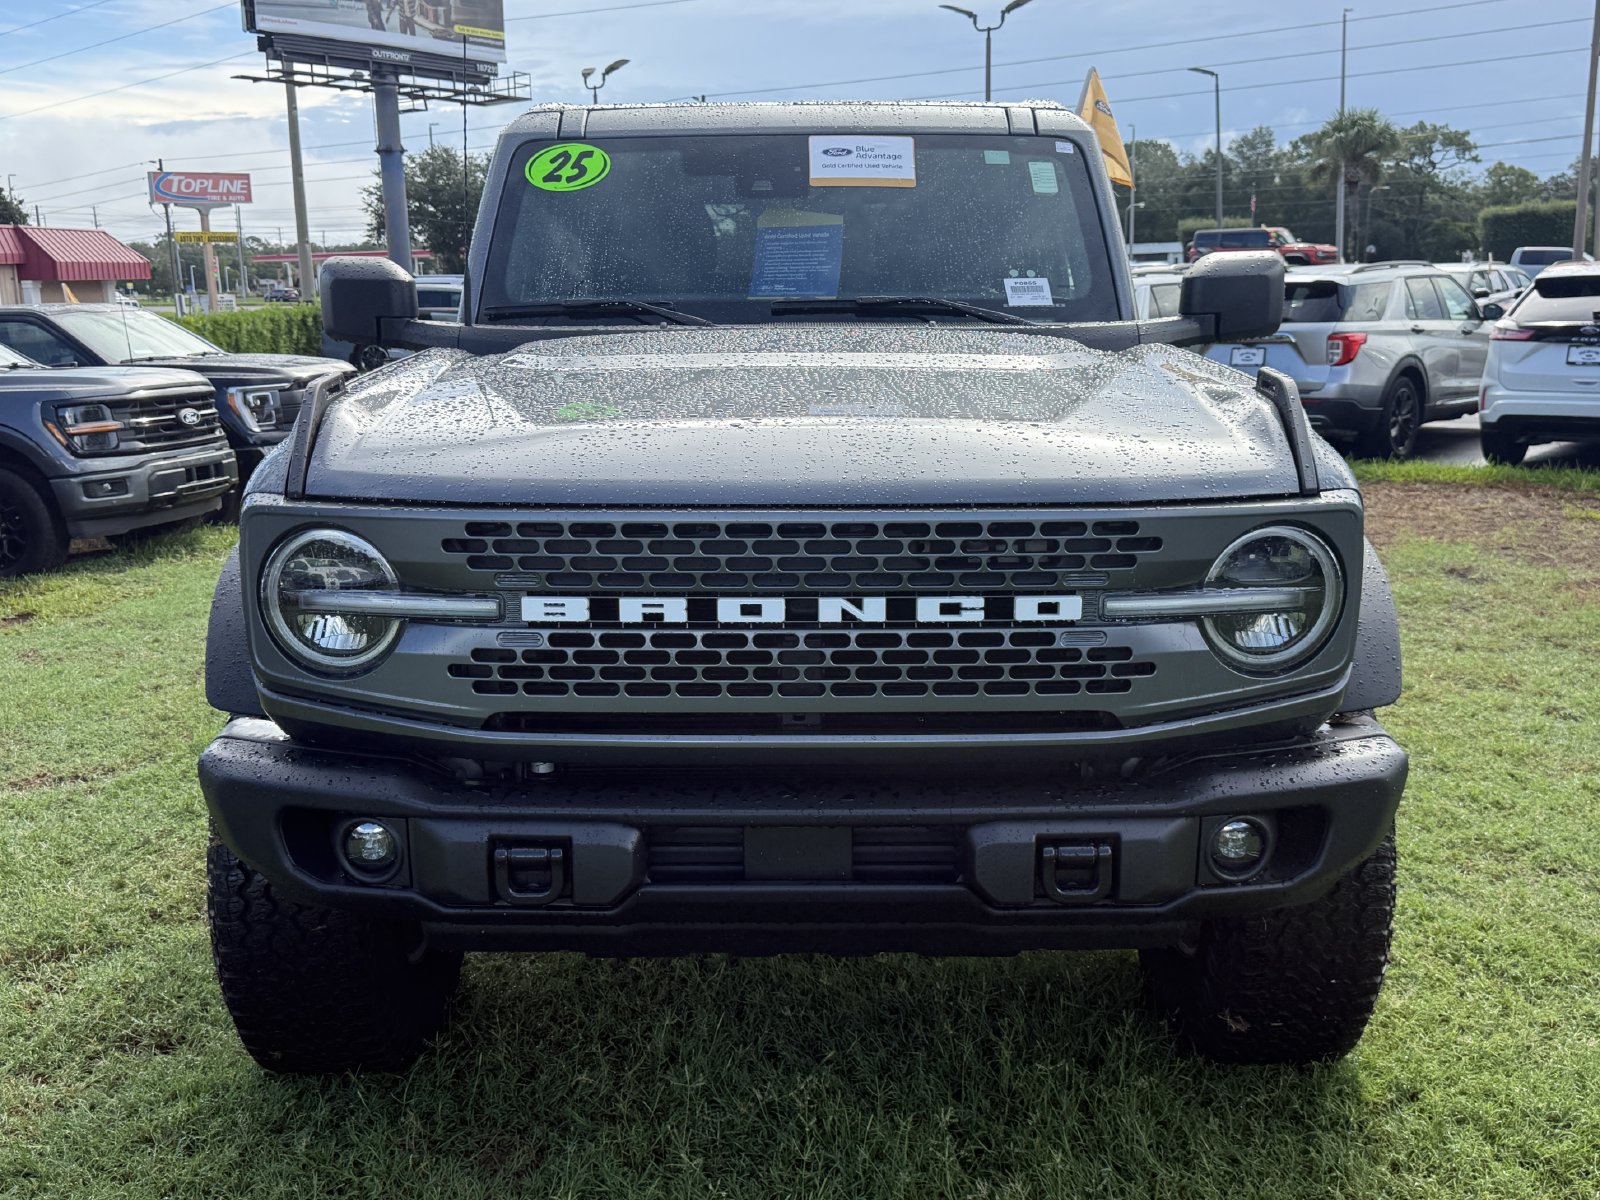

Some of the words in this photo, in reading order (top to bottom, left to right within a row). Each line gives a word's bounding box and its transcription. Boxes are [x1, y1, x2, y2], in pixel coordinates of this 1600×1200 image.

[826, 147, 849, 156] Ford
[855, 145, 875, 153] Blue
[855, 152, 903, 160] Advantage
[542, 150, 595, 184] 25
[169, 175, 249, 194] TOPLINE
[521, 595, 1083, 622] BRONCO
